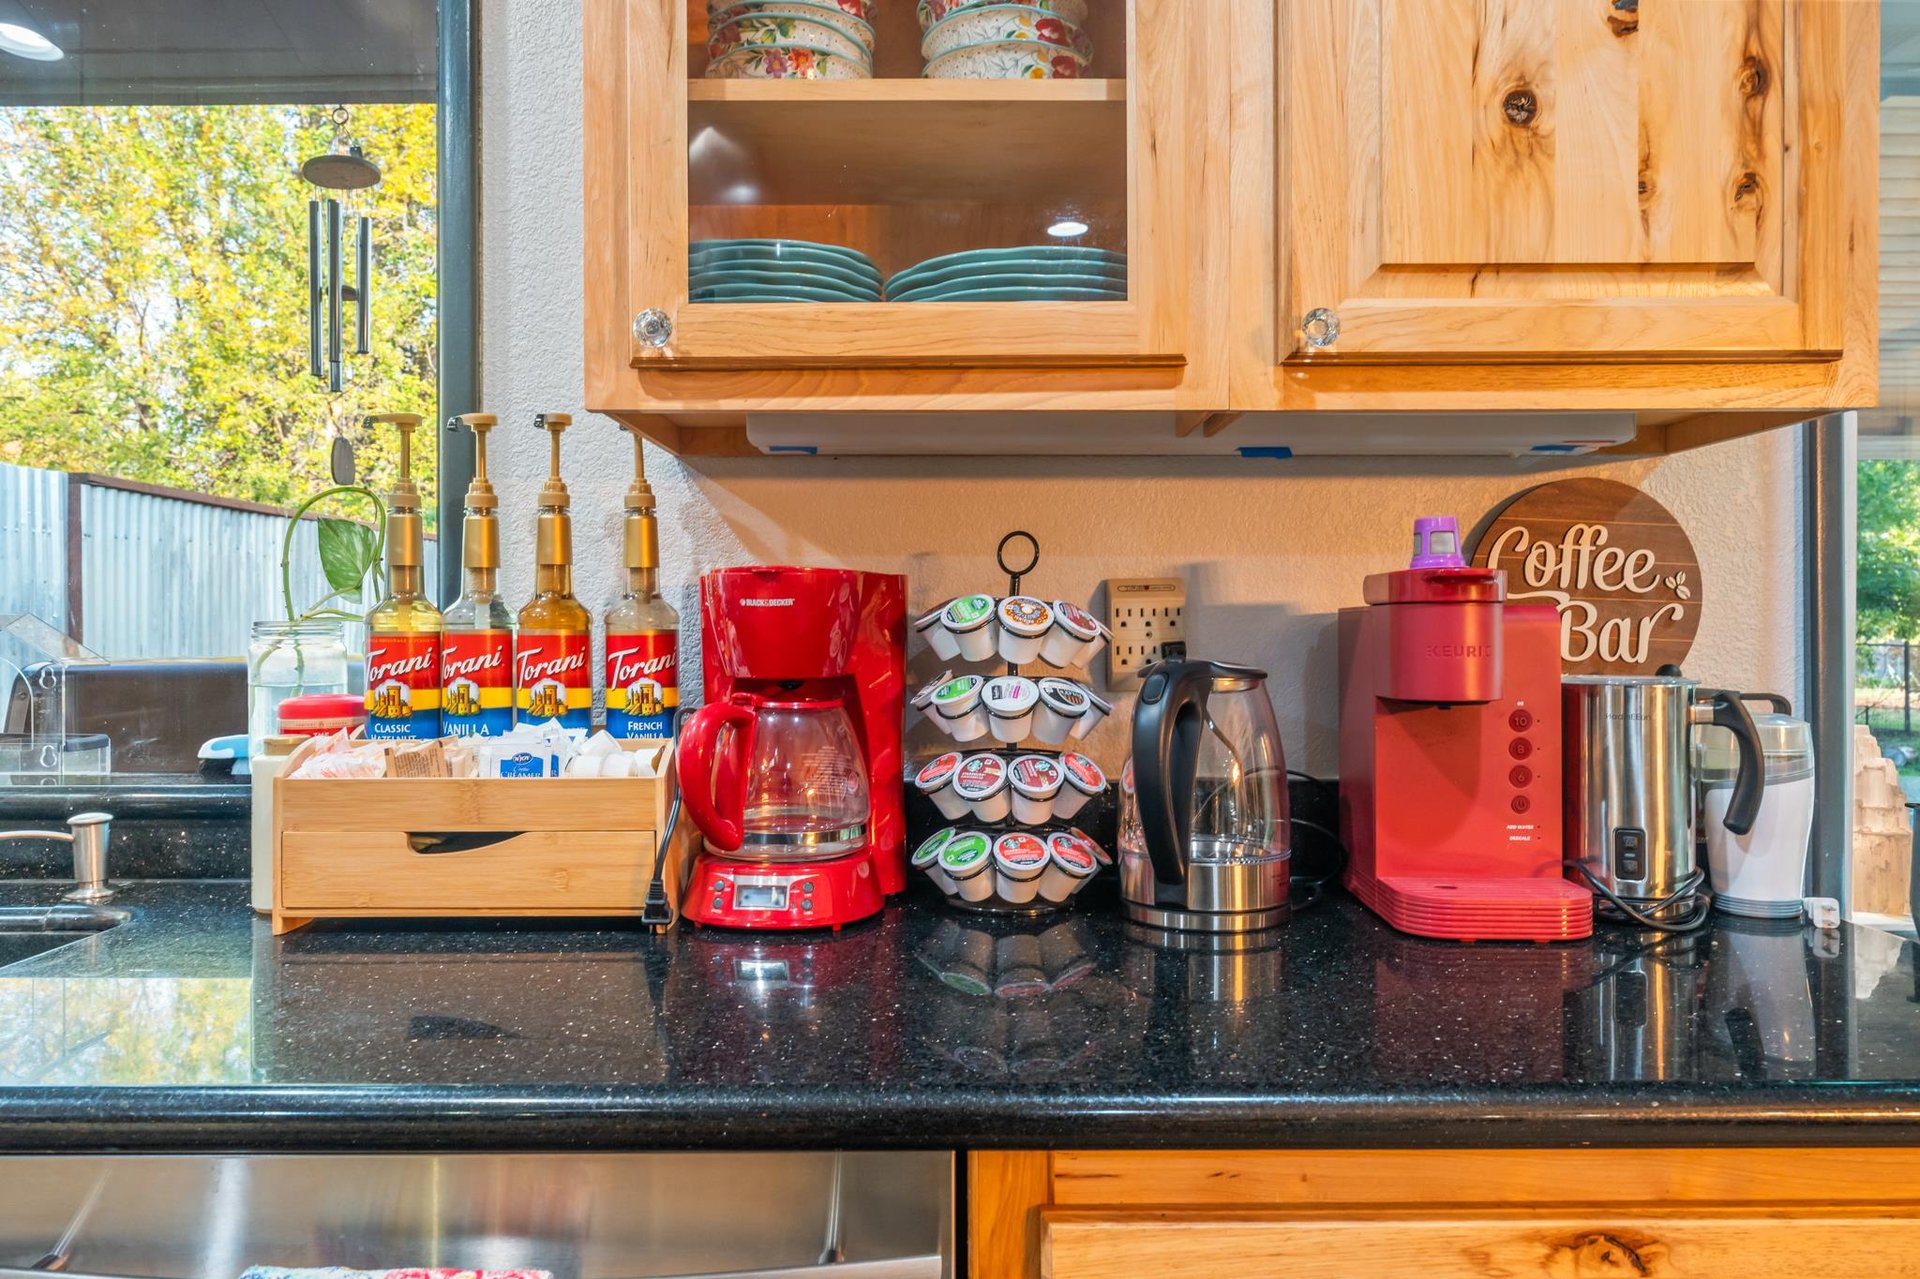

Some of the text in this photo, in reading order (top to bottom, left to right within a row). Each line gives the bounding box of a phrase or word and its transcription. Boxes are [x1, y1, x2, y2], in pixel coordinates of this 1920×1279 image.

[1487, 523, 1660, 594] Coffee
[1507, 590, 1685, 664] Bar
[366, 647, 433, 687] Torani
[441, 645, 503, 680] Torani
[516, 646, 586, 690] Torani
[608, 646, 677, 691] Torani
[374, 723, 412, 733] CLASSIC
[443, 721, 490, 736] VANILLA
[627, 721, 663, 731] FRENCH
[1514, 716, 1527, 727] 10
